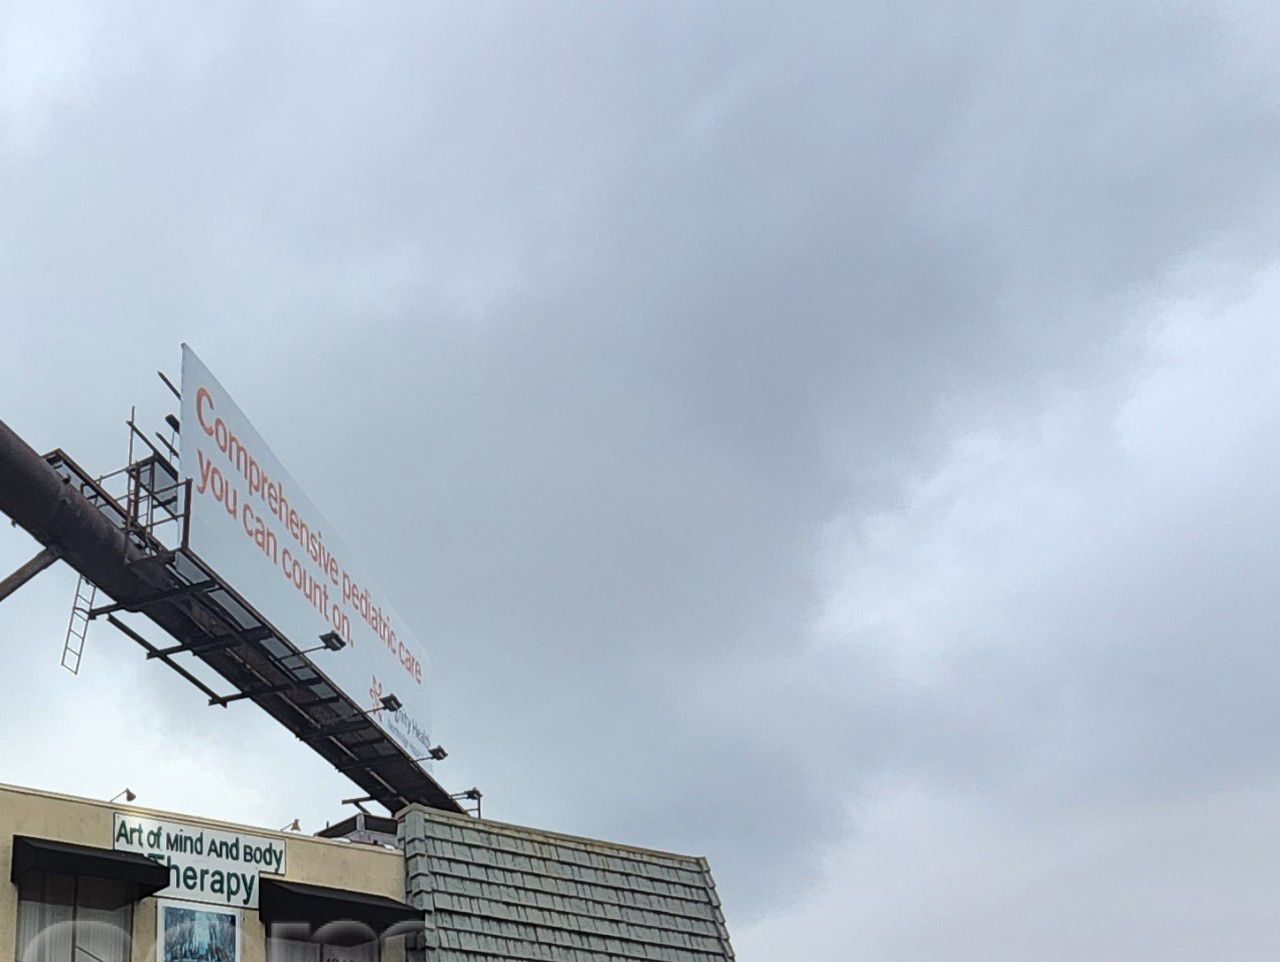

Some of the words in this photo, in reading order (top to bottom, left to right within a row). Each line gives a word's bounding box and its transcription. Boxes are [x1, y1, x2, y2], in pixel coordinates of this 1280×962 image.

[195, 386, 339, 587] Comprehensive
[342, 571, 397, 658] pediatric
[398, 639, 423, 685] care
[197, 449, 238, 520] you
[243, 502, 278, 566] can
[282, 547, 329, 617] count
[332, 603, 355, 648] on.
[115, 819, 144, 848] Art
[147, 826, 163, 849] of
[166, 830, 204, 857] Mind
[207, 837, 240, 861] And
[243, 842, 284, 870] Body
